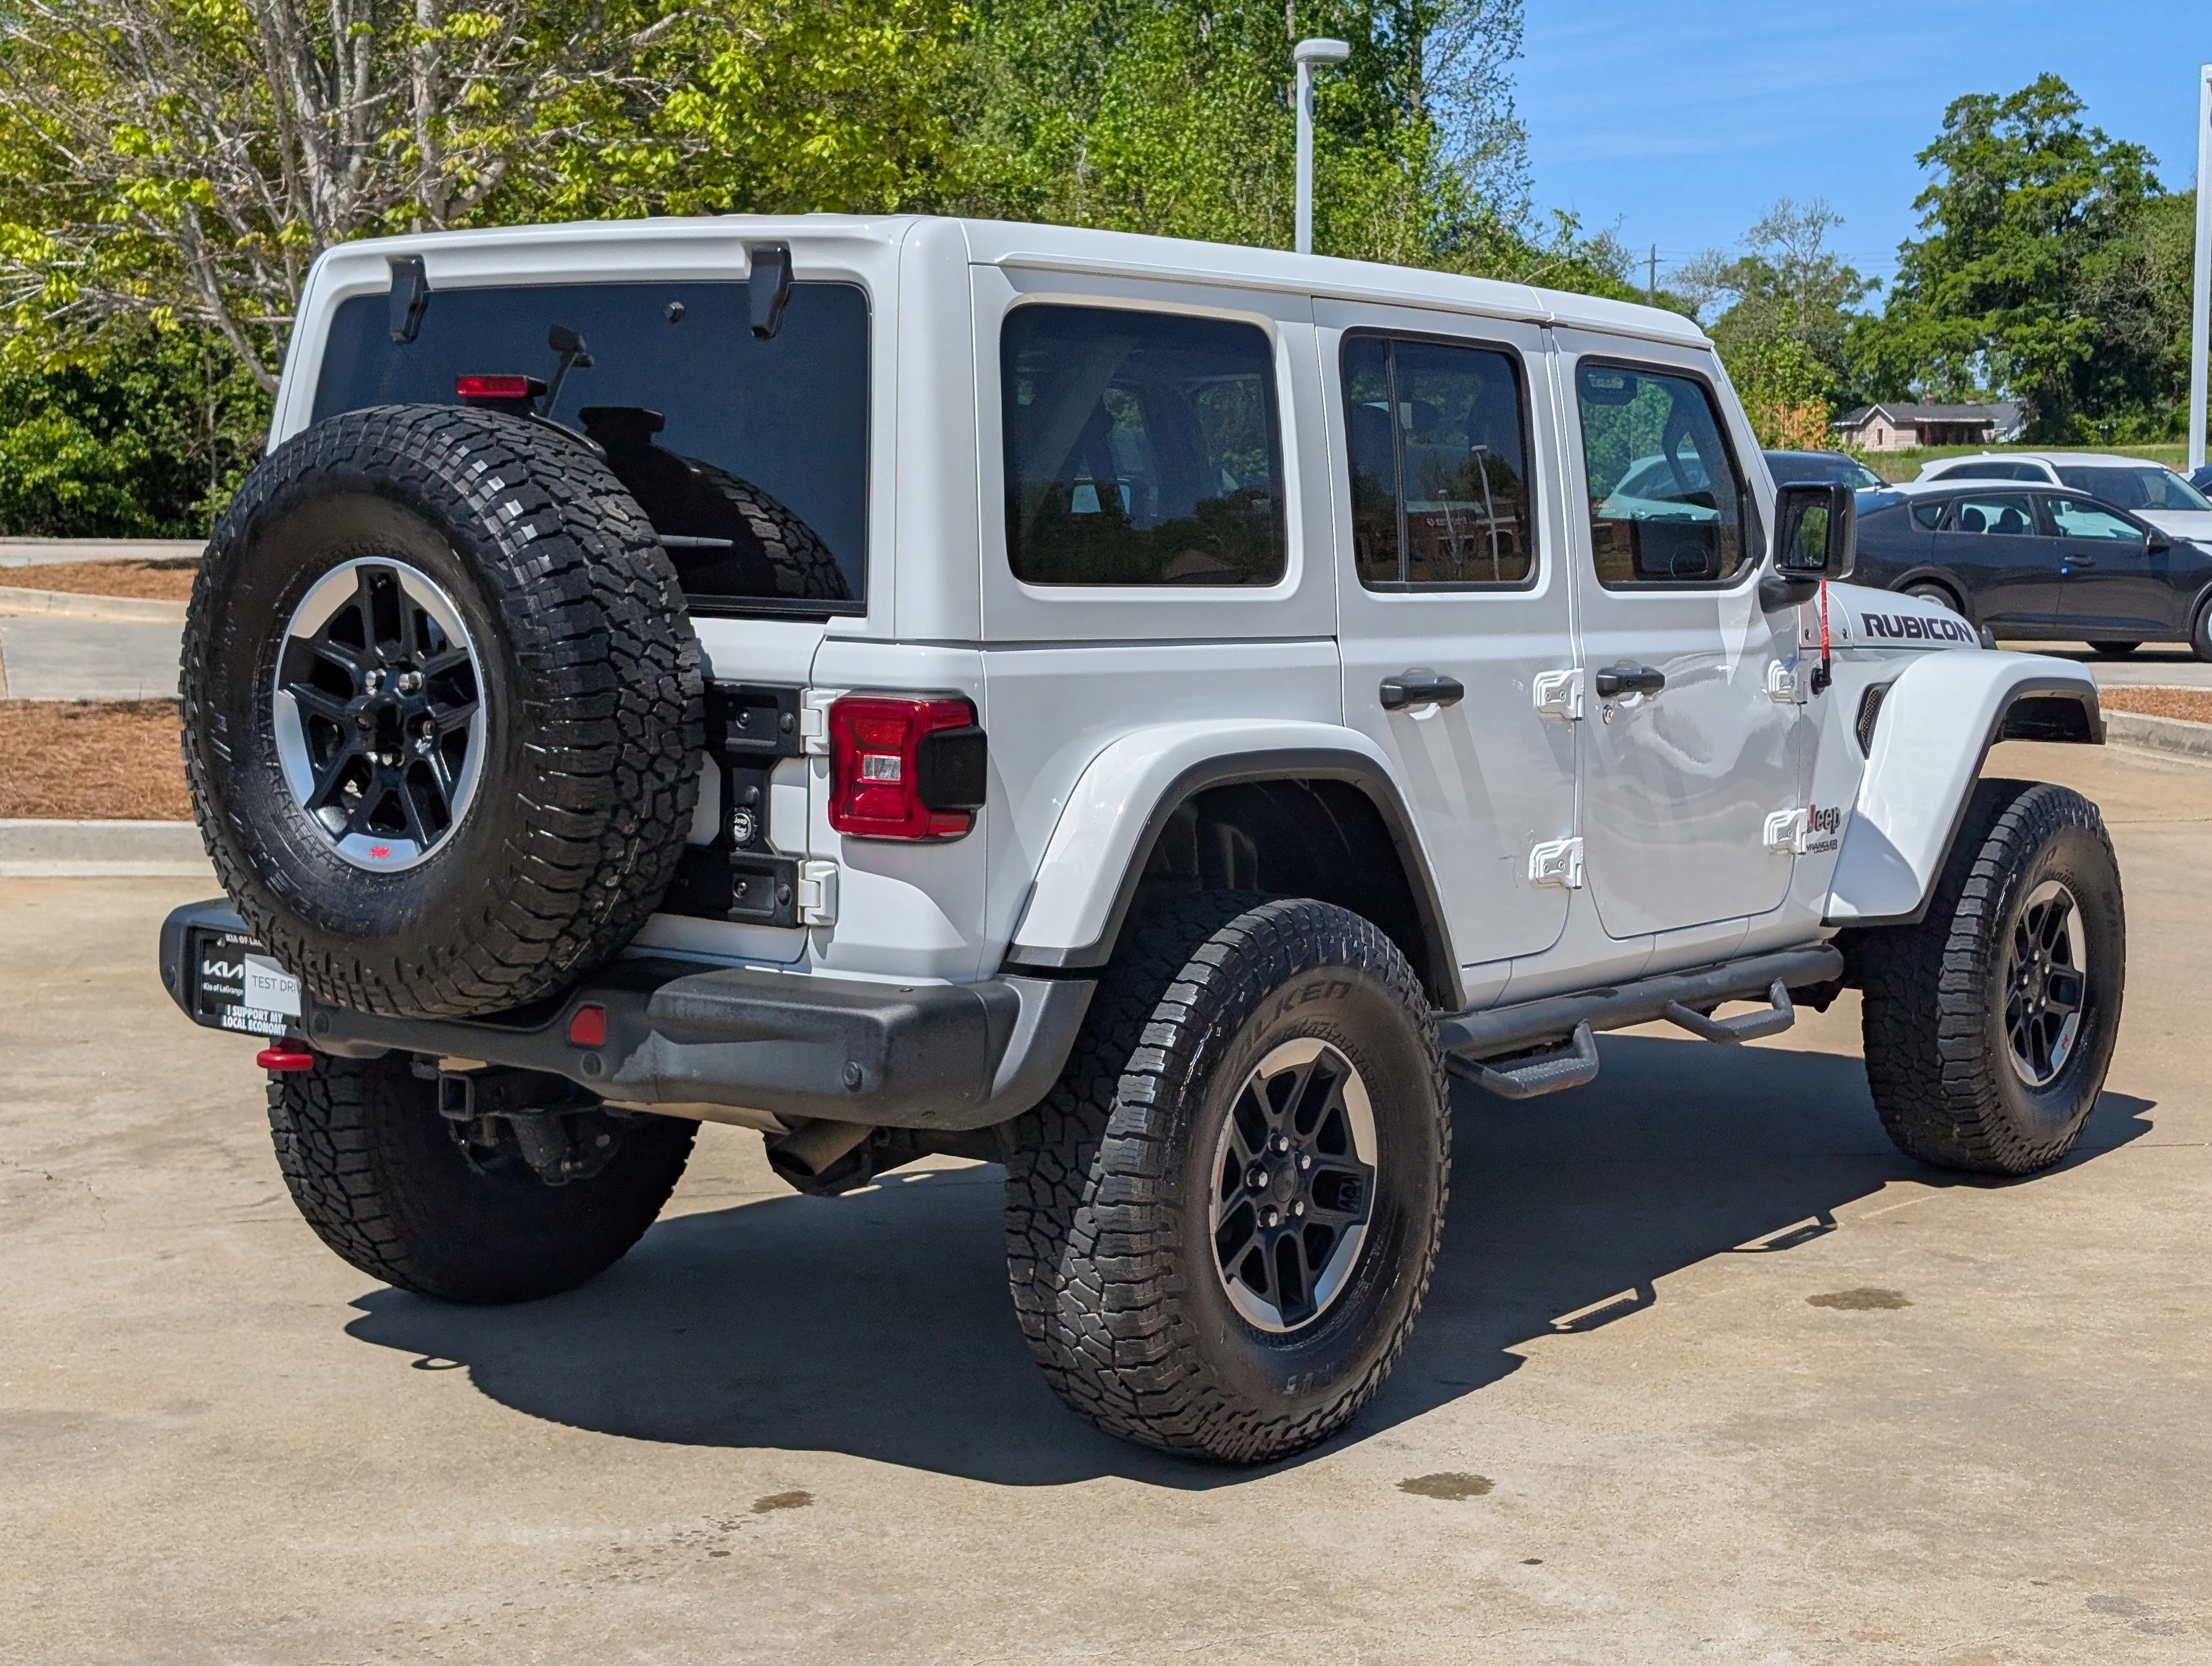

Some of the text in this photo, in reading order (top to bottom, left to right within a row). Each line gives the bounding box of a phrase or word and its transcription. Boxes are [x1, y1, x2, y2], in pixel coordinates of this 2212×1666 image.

[1860, 612, 1975, 644] RUBICON
[1806, 804, 1841, 835] Jeep
[226, 933, 239, 944] KIA
[252, 975, 277, 990] TEST
[227, 1004, 284, 1024] I SUPPORT MY
[222, 1014, 287, 1036] LOCAL ECONOMY
